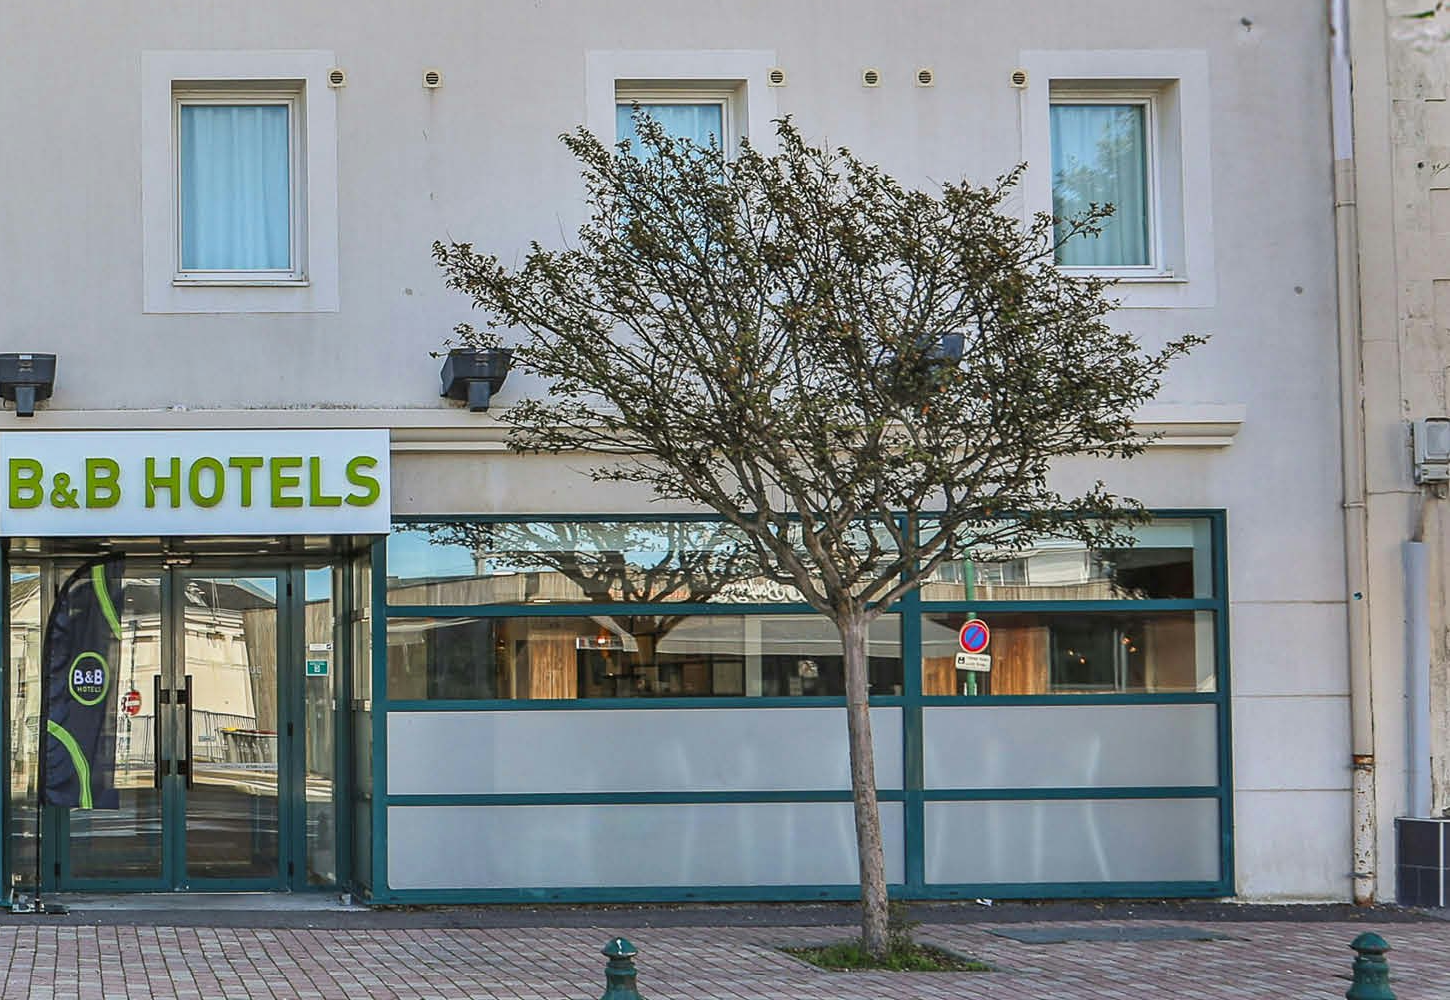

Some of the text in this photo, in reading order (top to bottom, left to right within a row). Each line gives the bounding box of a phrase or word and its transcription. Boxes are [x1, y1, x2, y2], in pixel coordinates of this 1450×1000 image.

[8, 455, 381, 509] B&B HOTELS
[73, 669, 103, 685] B&B
